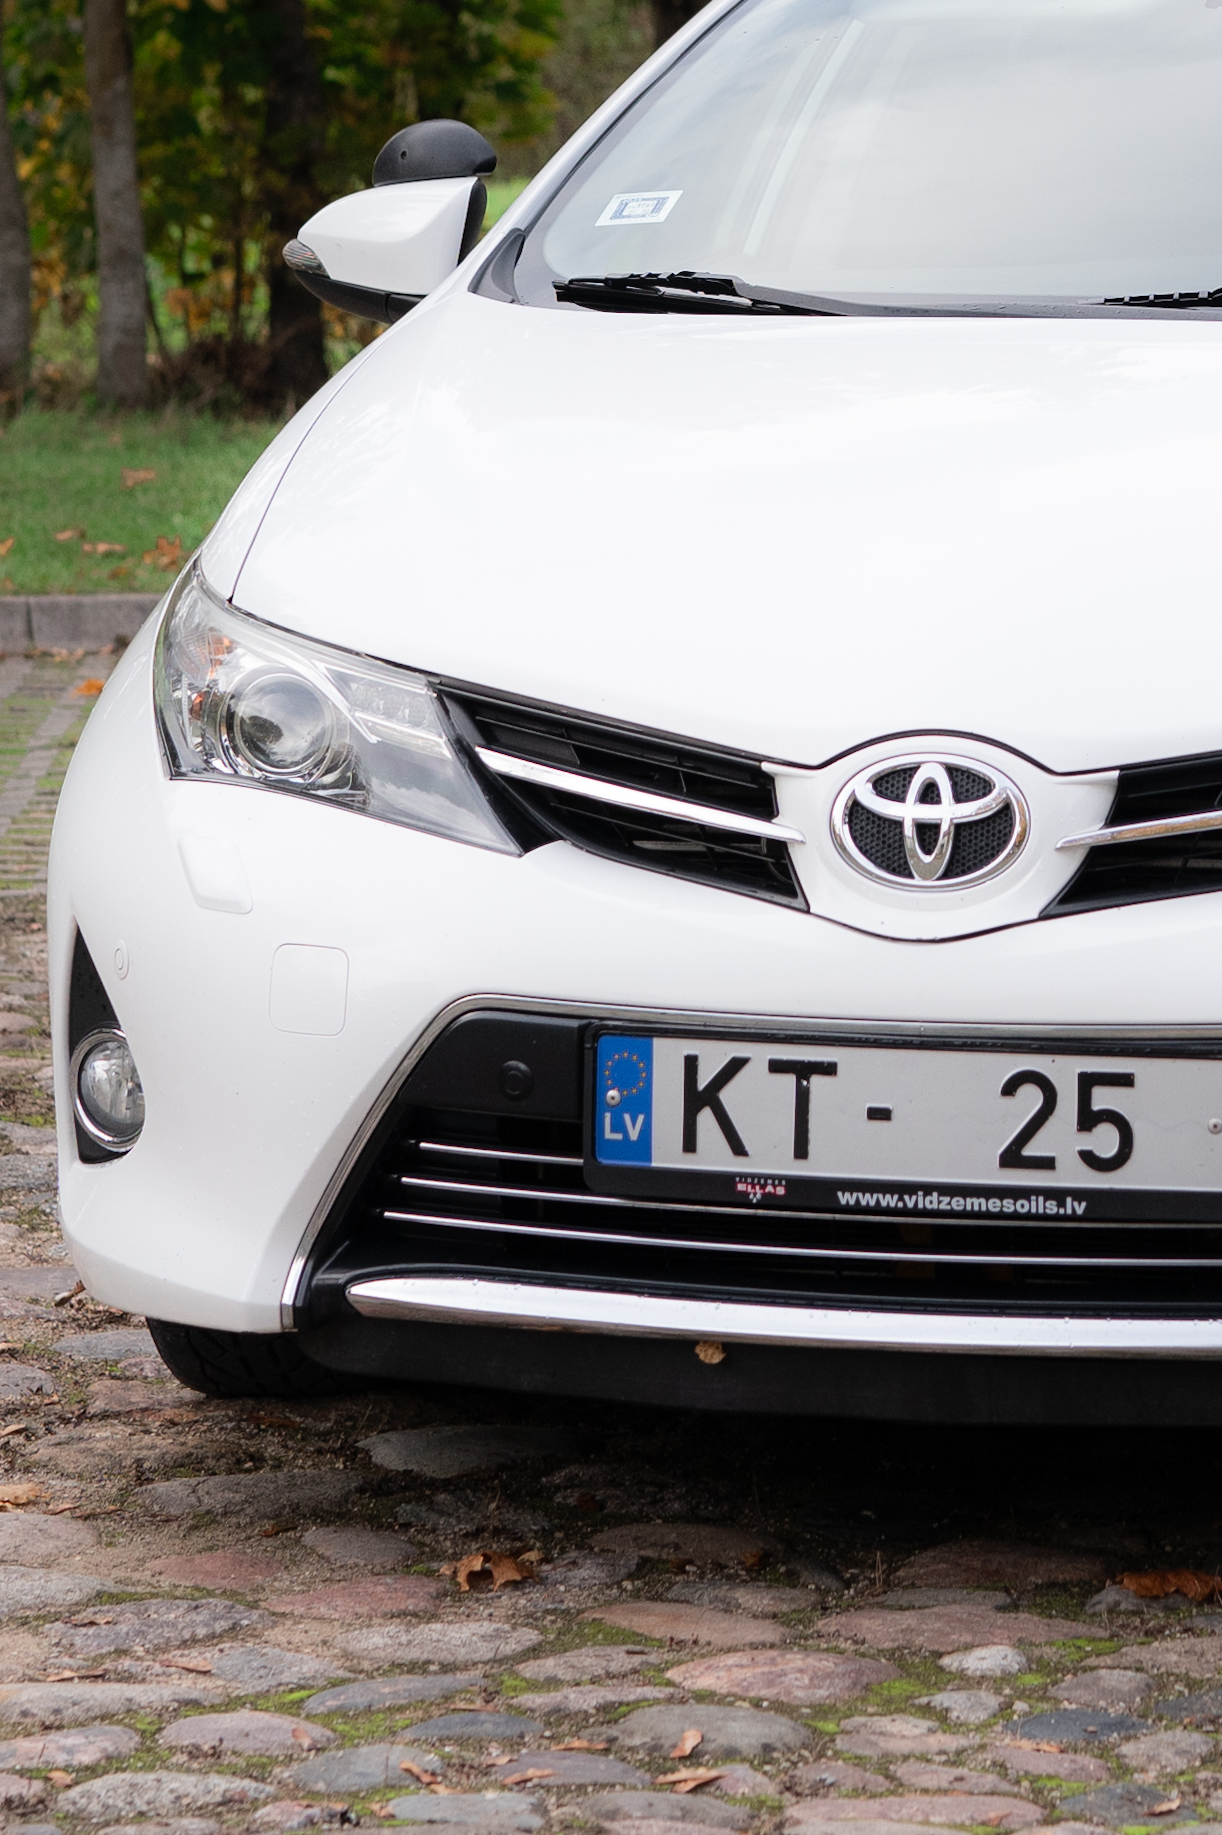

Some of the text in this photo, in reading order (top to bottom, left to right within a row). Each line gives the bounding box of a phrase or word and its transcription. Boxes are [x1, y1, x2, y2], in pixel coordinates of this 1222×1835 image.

[604, 1112, 645, 1141] LV
[998, 1068, 1136, 1173] 25
[837, 1191, 1087, 1215] www.vidzemesoils.lv
